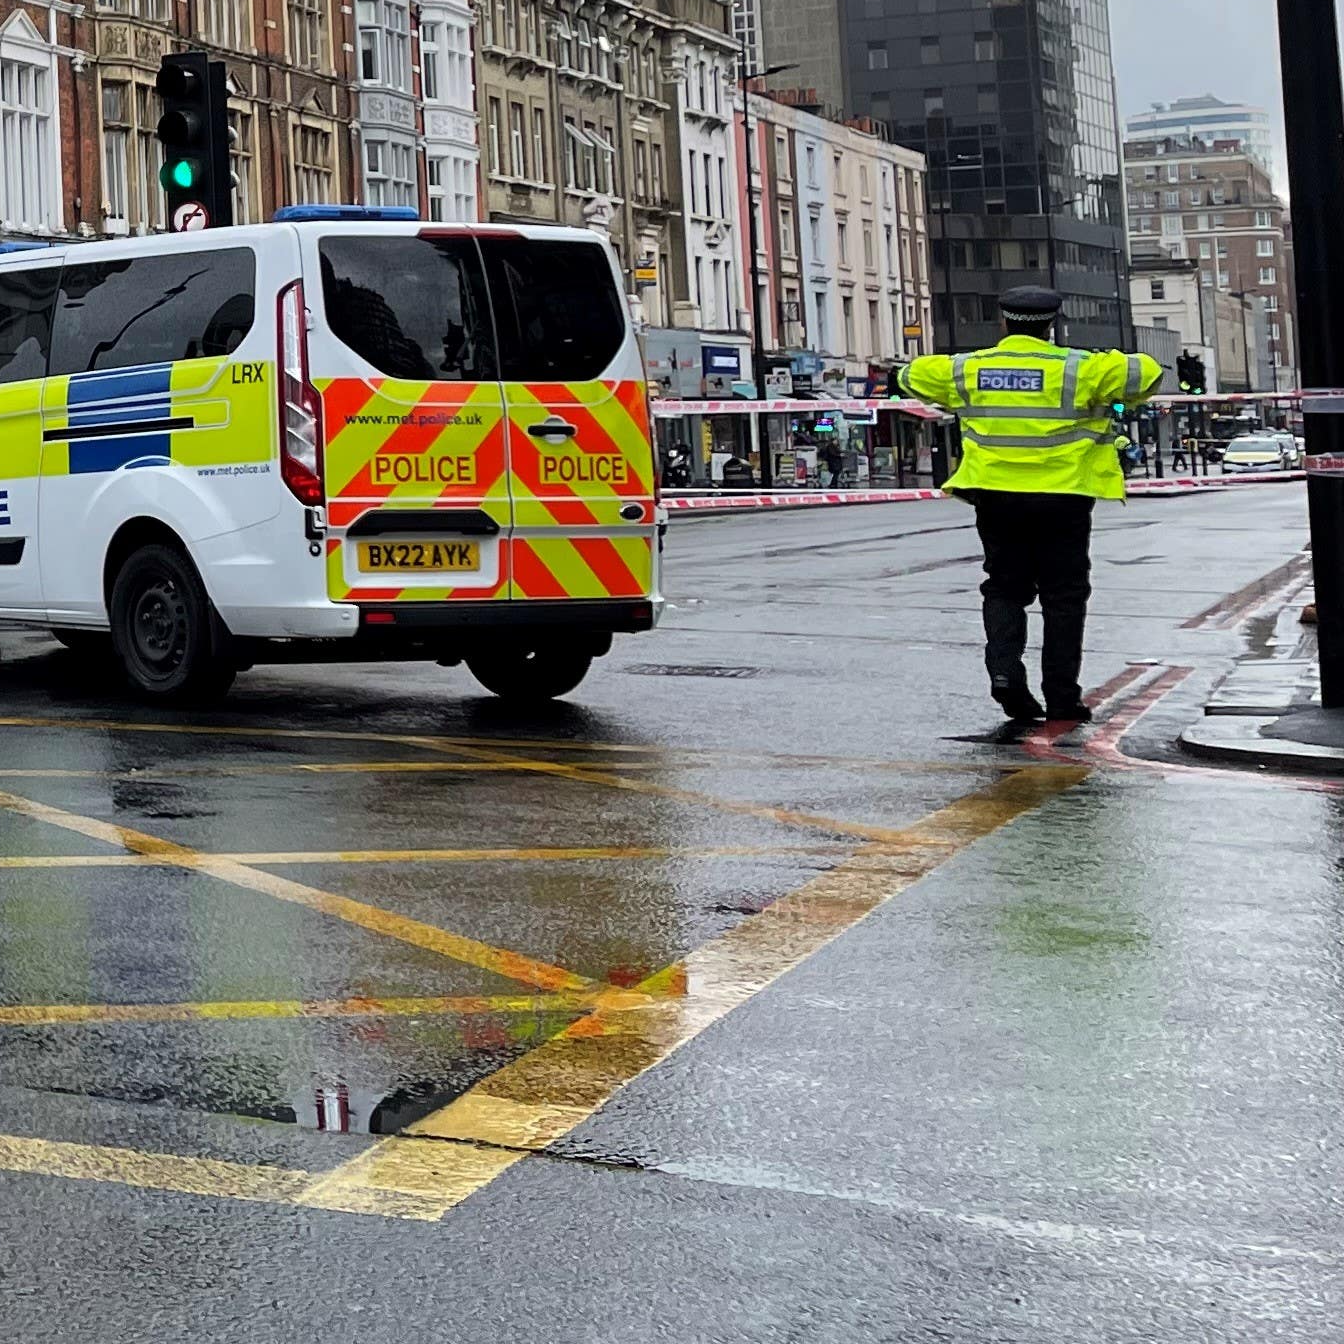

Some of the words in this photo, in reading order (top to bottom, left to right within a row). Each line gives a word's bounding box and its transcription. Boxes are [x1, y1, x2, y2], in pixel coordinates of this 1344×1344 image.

[232, 363, 265, 384] LRX
[980, 376, 1041, 390] POLICE
[343, 414, 483, 428] www.met.police.uk
[197, 464, 271, 477] www.met.police.uk
[375, 456, 472, 483] POLICE
[544, 455, 625, 482] POLICE
[369, 544, 425, 567] BX22
[432, 544, 472, 566] AYK
